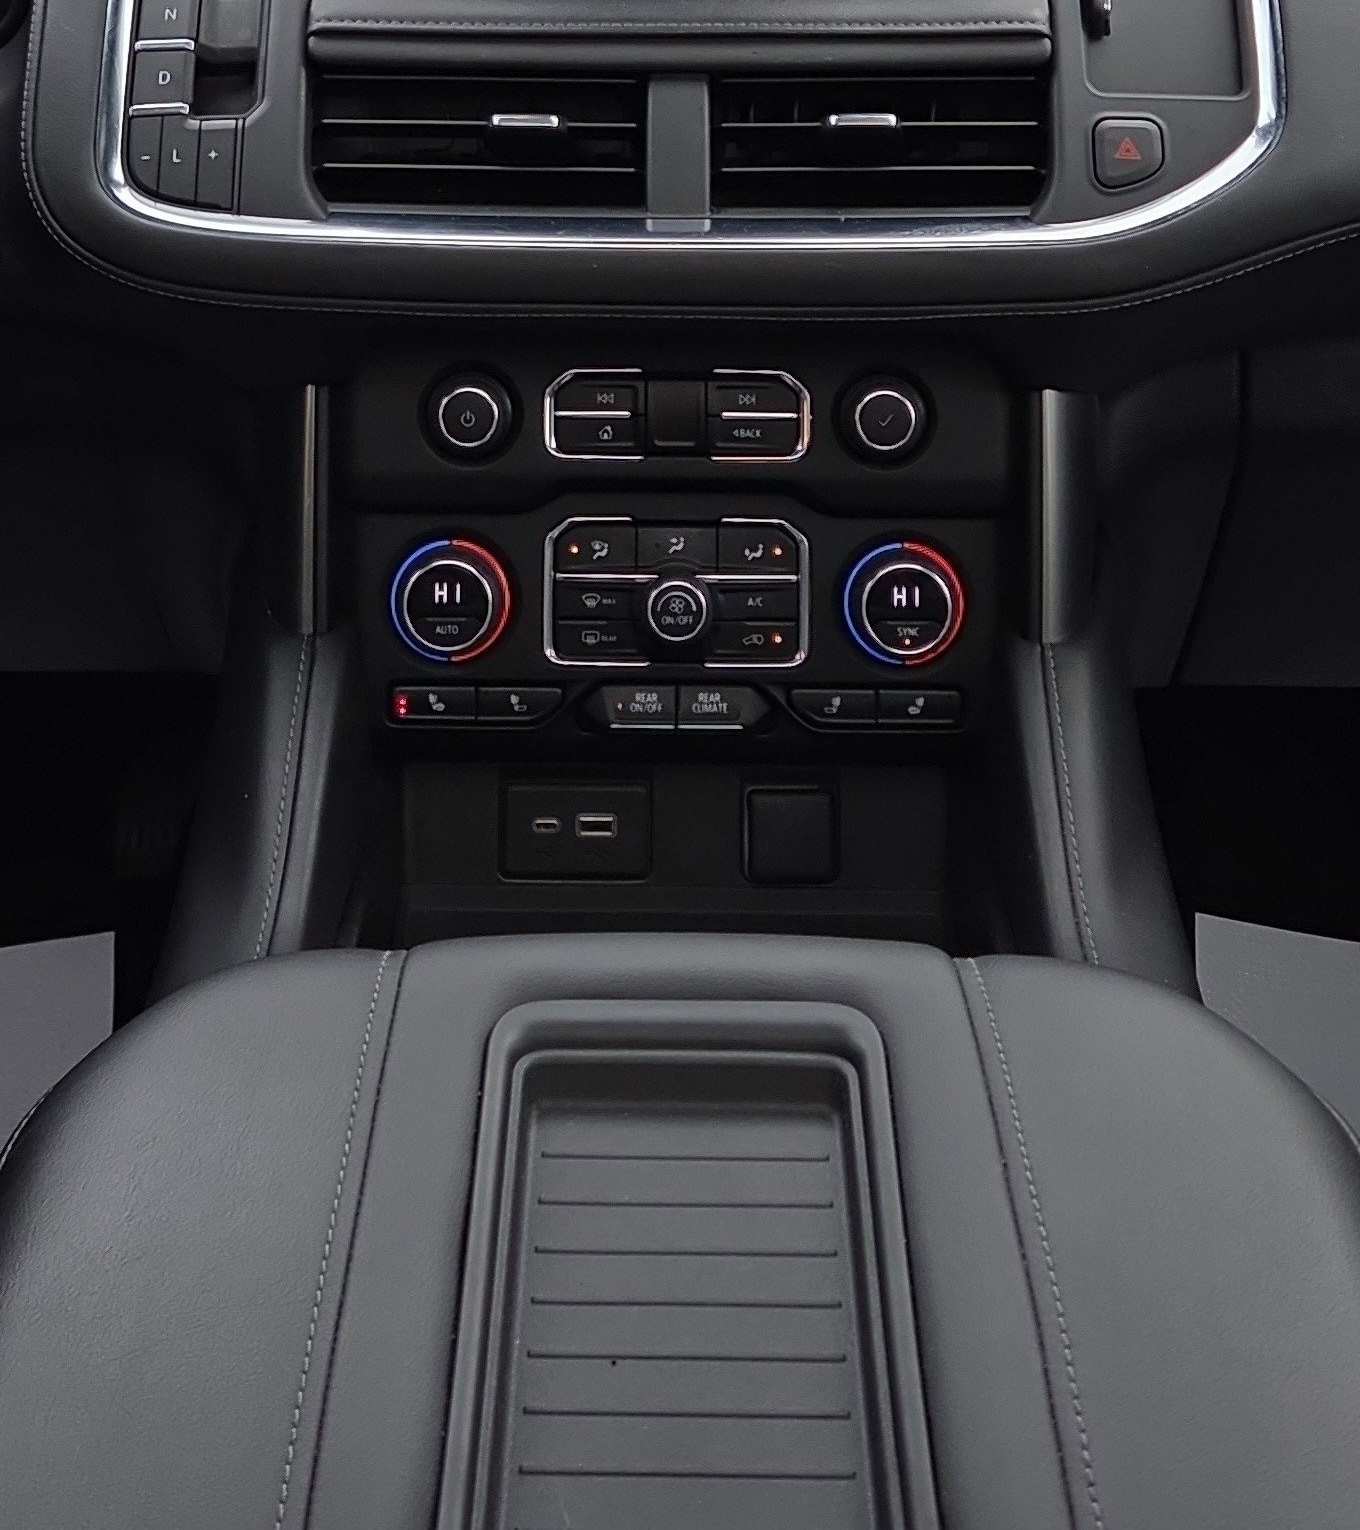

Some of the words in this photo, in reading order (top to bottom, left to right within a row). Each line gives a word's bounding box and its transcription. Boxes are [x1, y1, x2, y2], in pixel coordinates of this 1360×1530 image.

[164, 7, 178, 21] N
[158, 70, 171, 85] D
[172, 149, 181, 163] L
[740, 428, 762, 438] BACK
[434, 581, 461, 605] HI
[892, 585, 920, 608] HI
[747, 597, 763, 608] A/C
[661, 616, 694, 626] ON/OFF
[435, 624, 459, 635] AUTO
[896, 626, 920, 637] SYNC
[635, 692, 658, 702] REAR
[698, 692, 721, 702] REAR
[629, 702, 662, 713] ON/OFF
[692, 702, 728, 714] CLIMATE
